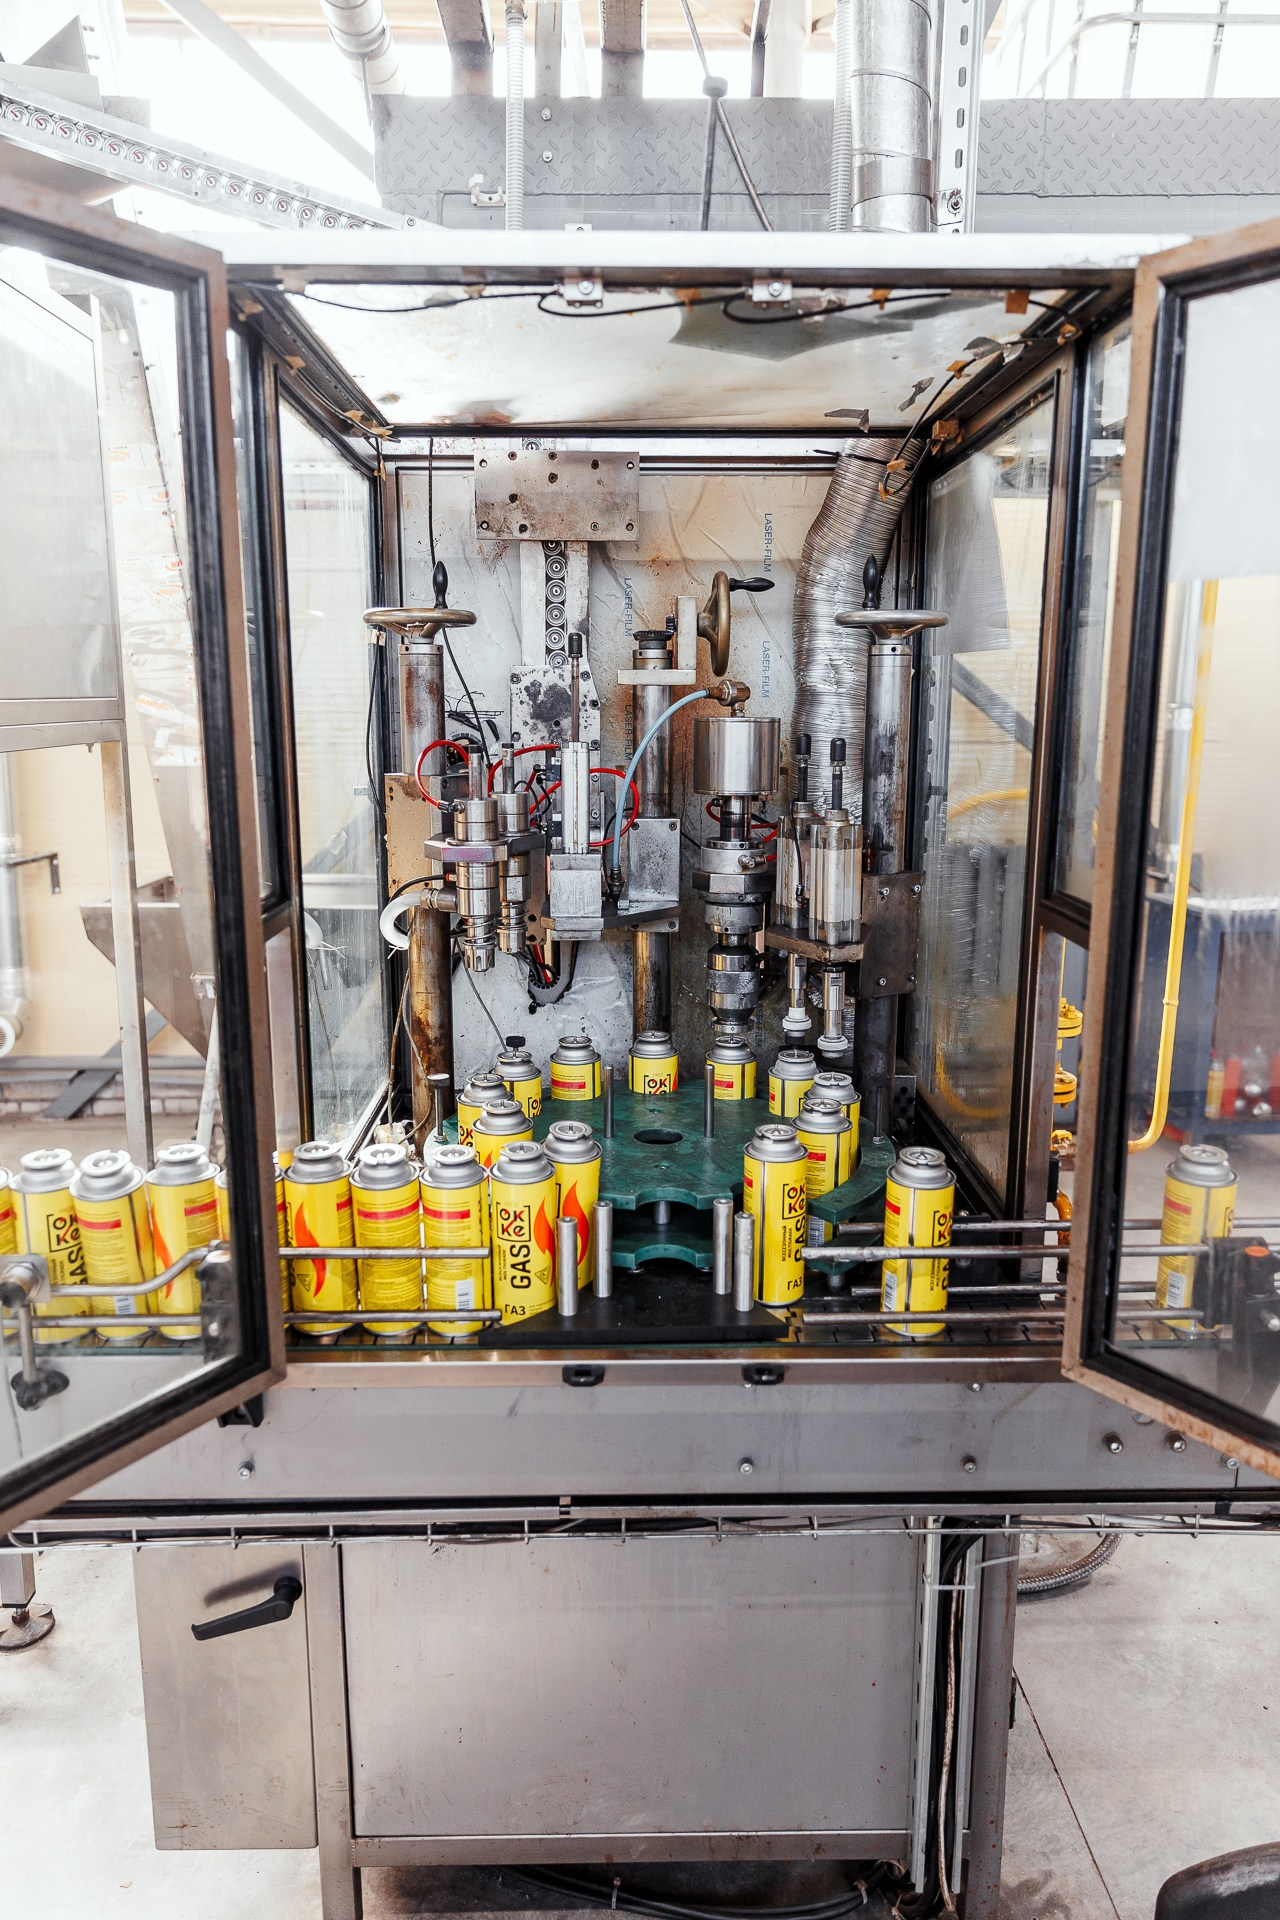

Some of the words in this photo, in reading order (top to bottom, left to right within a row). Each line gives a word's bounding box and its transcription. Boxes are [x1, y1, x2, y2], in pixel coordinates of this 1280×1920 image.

[764, 513, 773, 573] LASER-FILM
[624, 577, 633, 637] LASER-FILM
[762, 640, 770, 698] LASER-FILM
[624, 704, 633, 761] LASER-FILM
[509, 1244, 531, 1289] GAS
[787, 1276, 803, 1291] ГАЗ
[504, 1304, 526, 1316] ГАЗ
